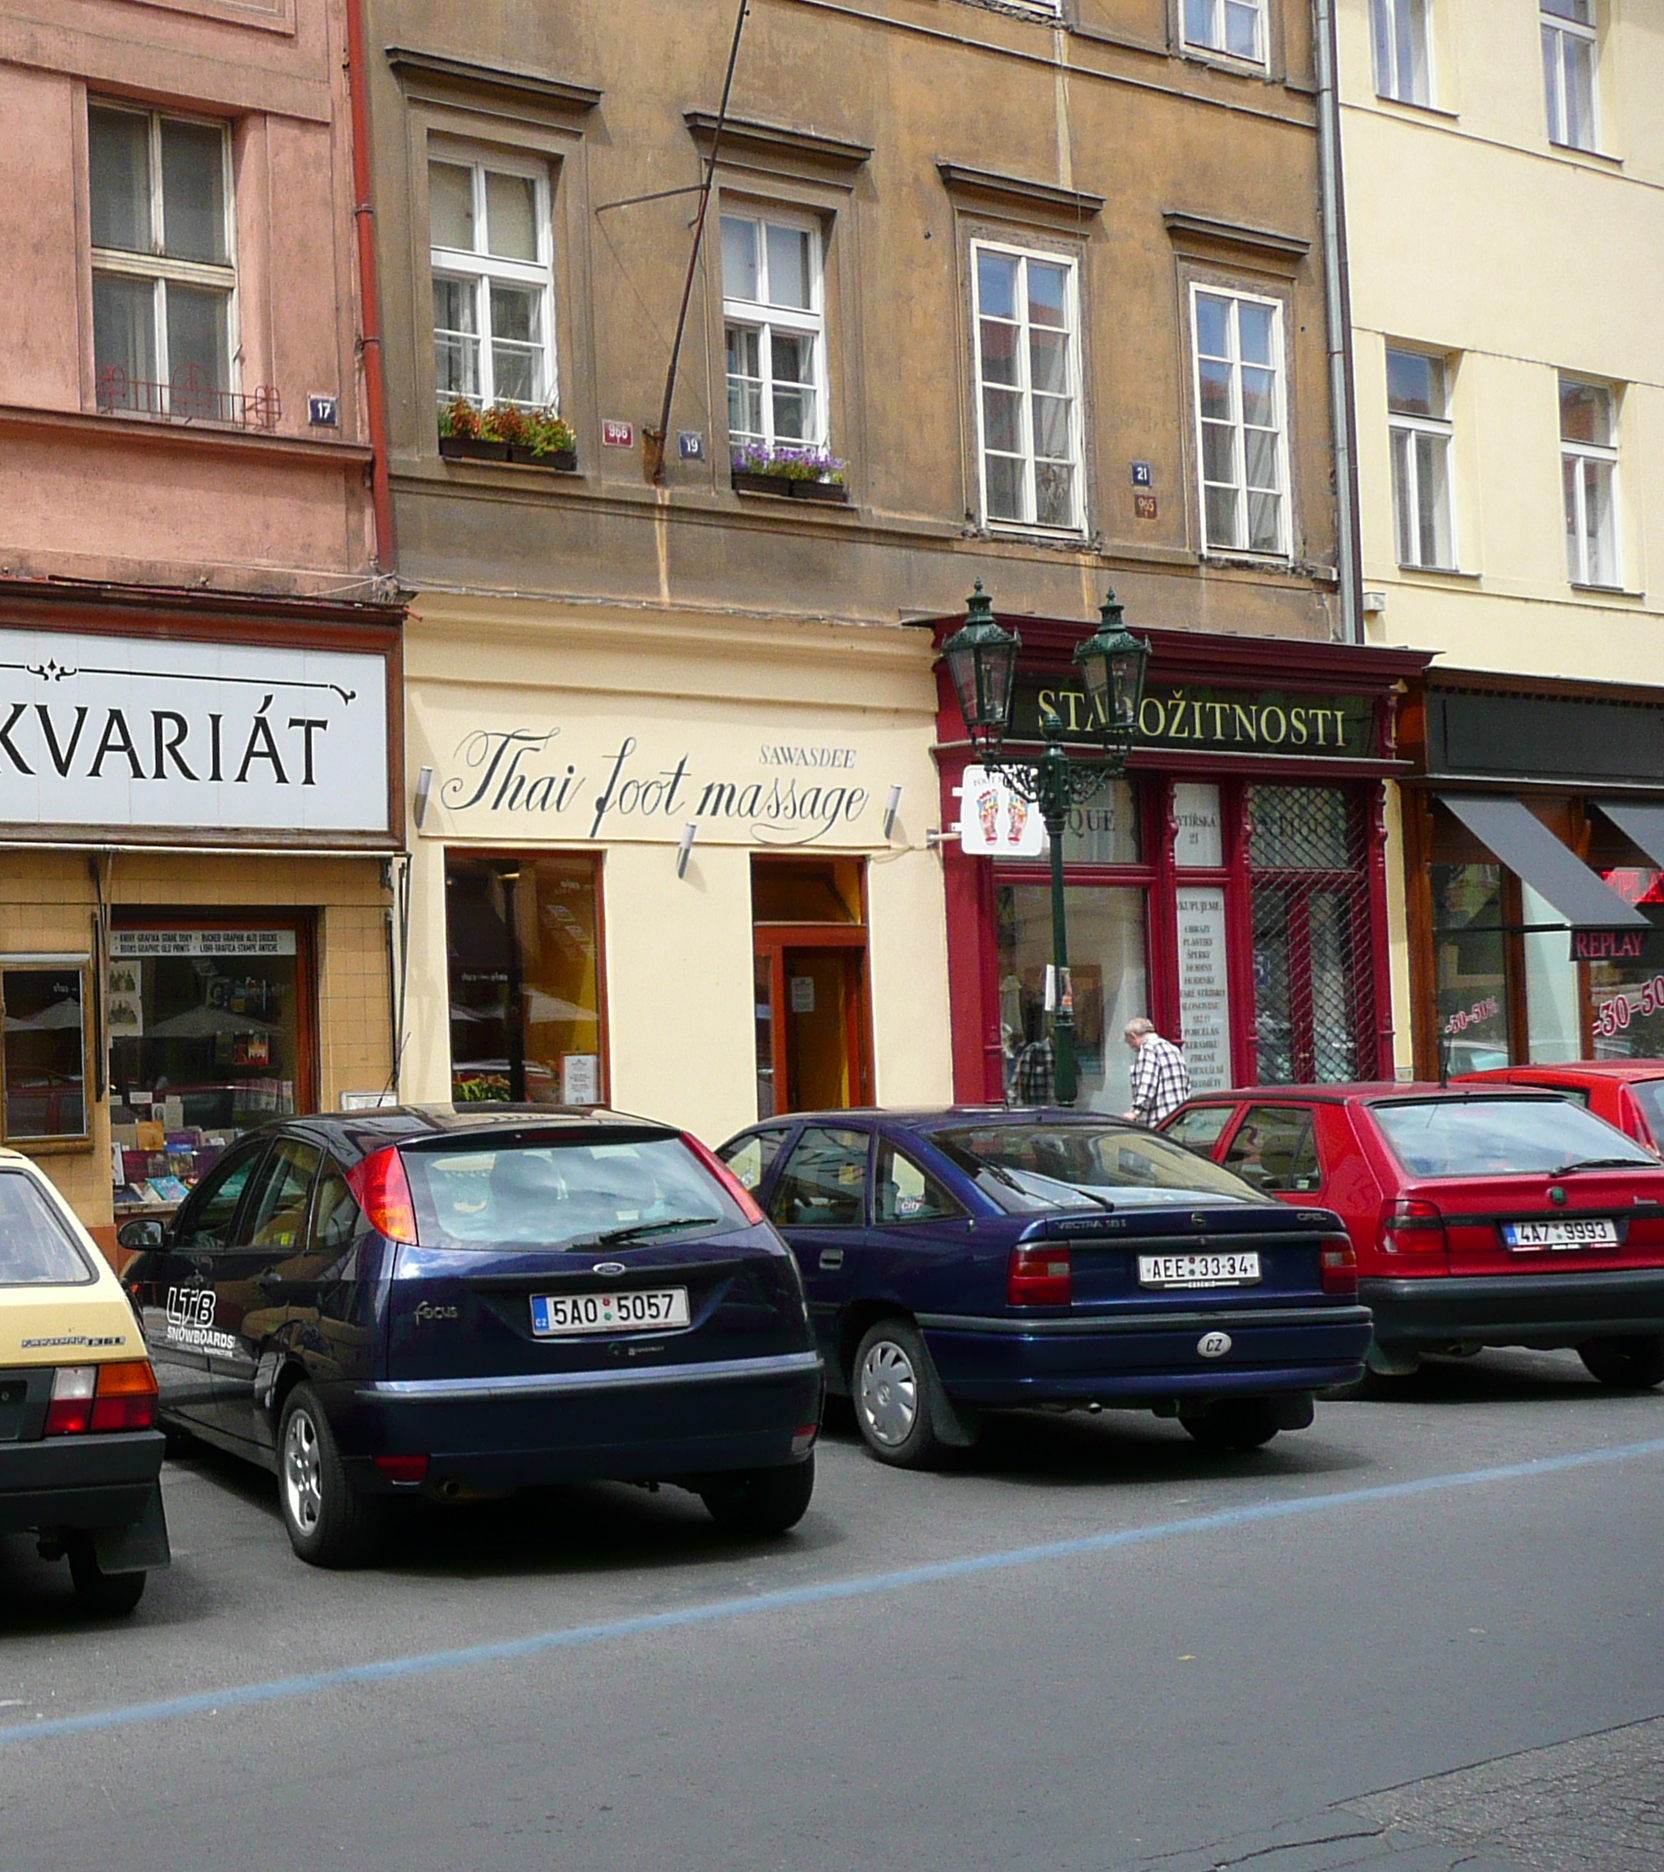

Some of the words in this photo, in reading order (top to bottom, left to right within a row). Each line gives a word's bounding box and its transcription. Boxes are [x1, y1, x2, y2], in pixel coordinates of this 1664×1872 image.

[317, 402, 331, 419] 17
[609, 424, 628, 439] 966
[686, 439, 699, 453] 19
[1137, 467, 1148, 480] 21
[758, 744, 857, 769] SAWASDEE
[441, 727, 586, 813] Thai
[589, 737, 692, 838] foot
[695, 777, 870, 846] massage
[1577, 932, 1644, 958] REPLAY
[1521, 1223, 1549, 1242] 4A7
[1564, 1221, 1607, 1240] 9993
[1153, 1259, 1185, 1279] AEE
[1200, 1256, 1248, 1276] 33-34
[167, 1287, 216, 1328] LTB
[617, 1294, 674, 1321] 5057
[167, 1325, 234, 1349] SNOWBOARDS
[1206, 1339, 1223, 1352] CZ
